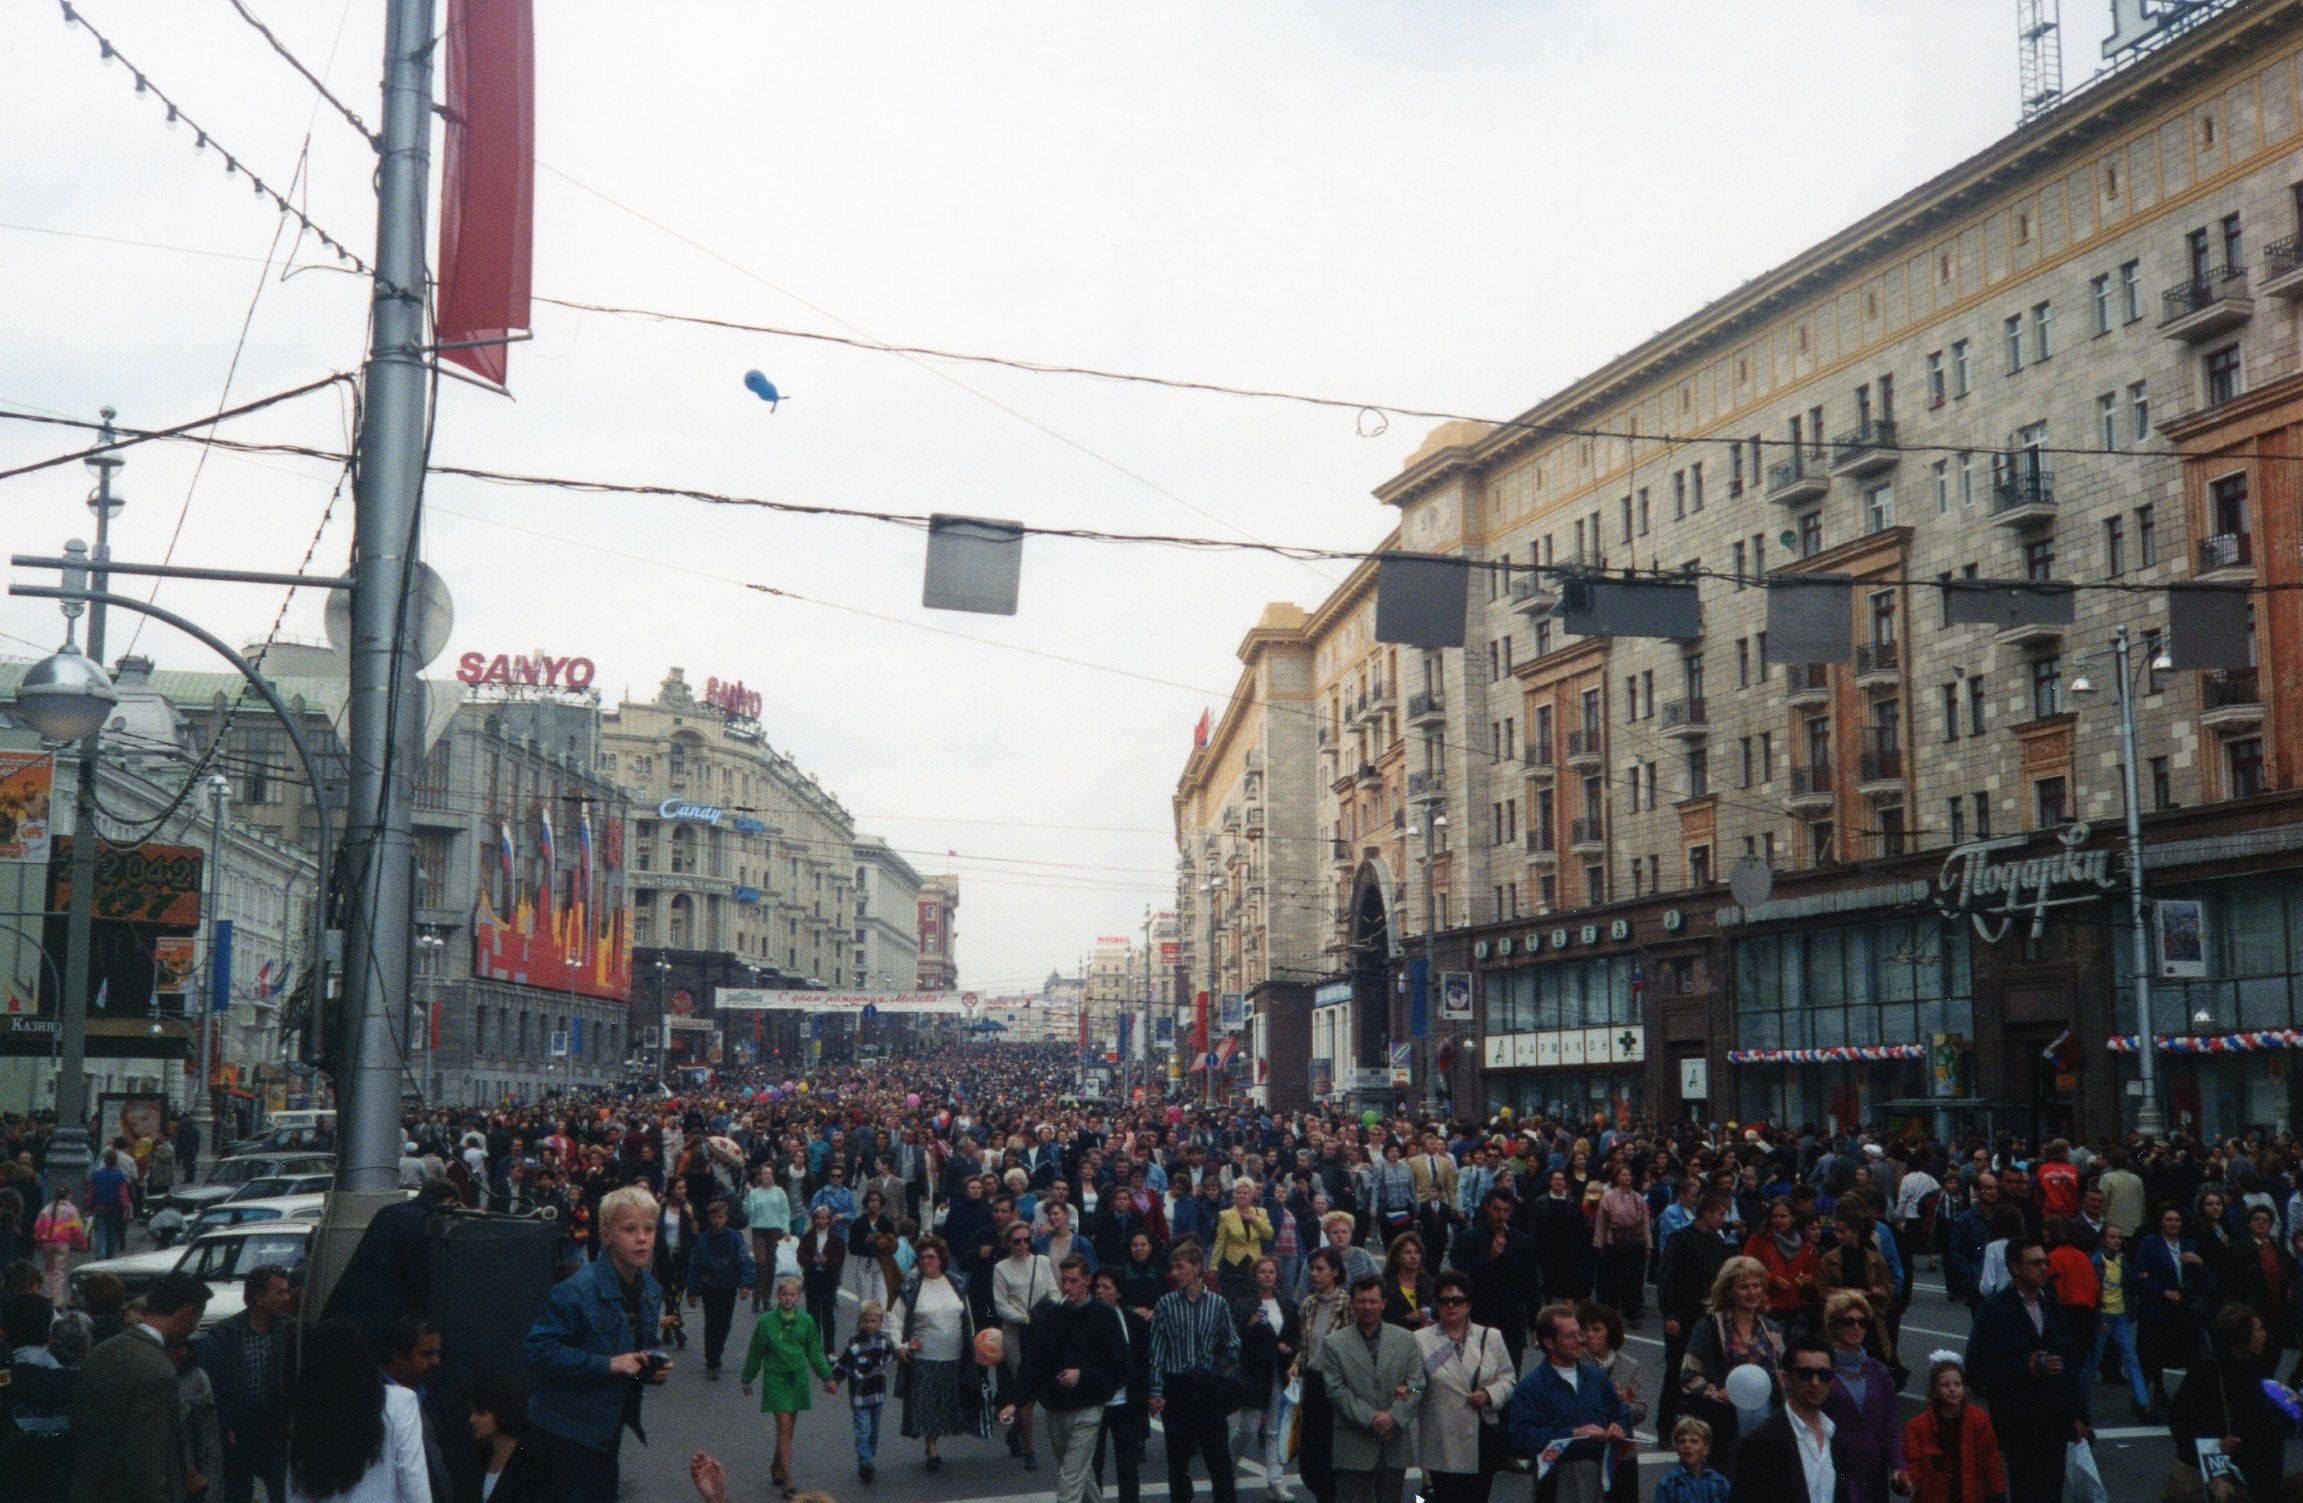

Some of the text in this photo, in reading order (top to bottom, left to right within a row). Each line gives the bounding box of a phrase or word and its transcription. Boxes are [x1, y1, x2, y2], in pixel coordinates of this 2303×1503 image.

[456, 651, 596, 688] SANYO
[659, 797, 723, 825] Candy
[1934, 821, 2117, 943] Подарки
[1475, 918, 1628, 960] АПТЕКА
[777, 990, 789, 1002] С
[791, 993, 821, 1004] днем
[1518, 1039, 1607, 1056] ФАРМАКОН
